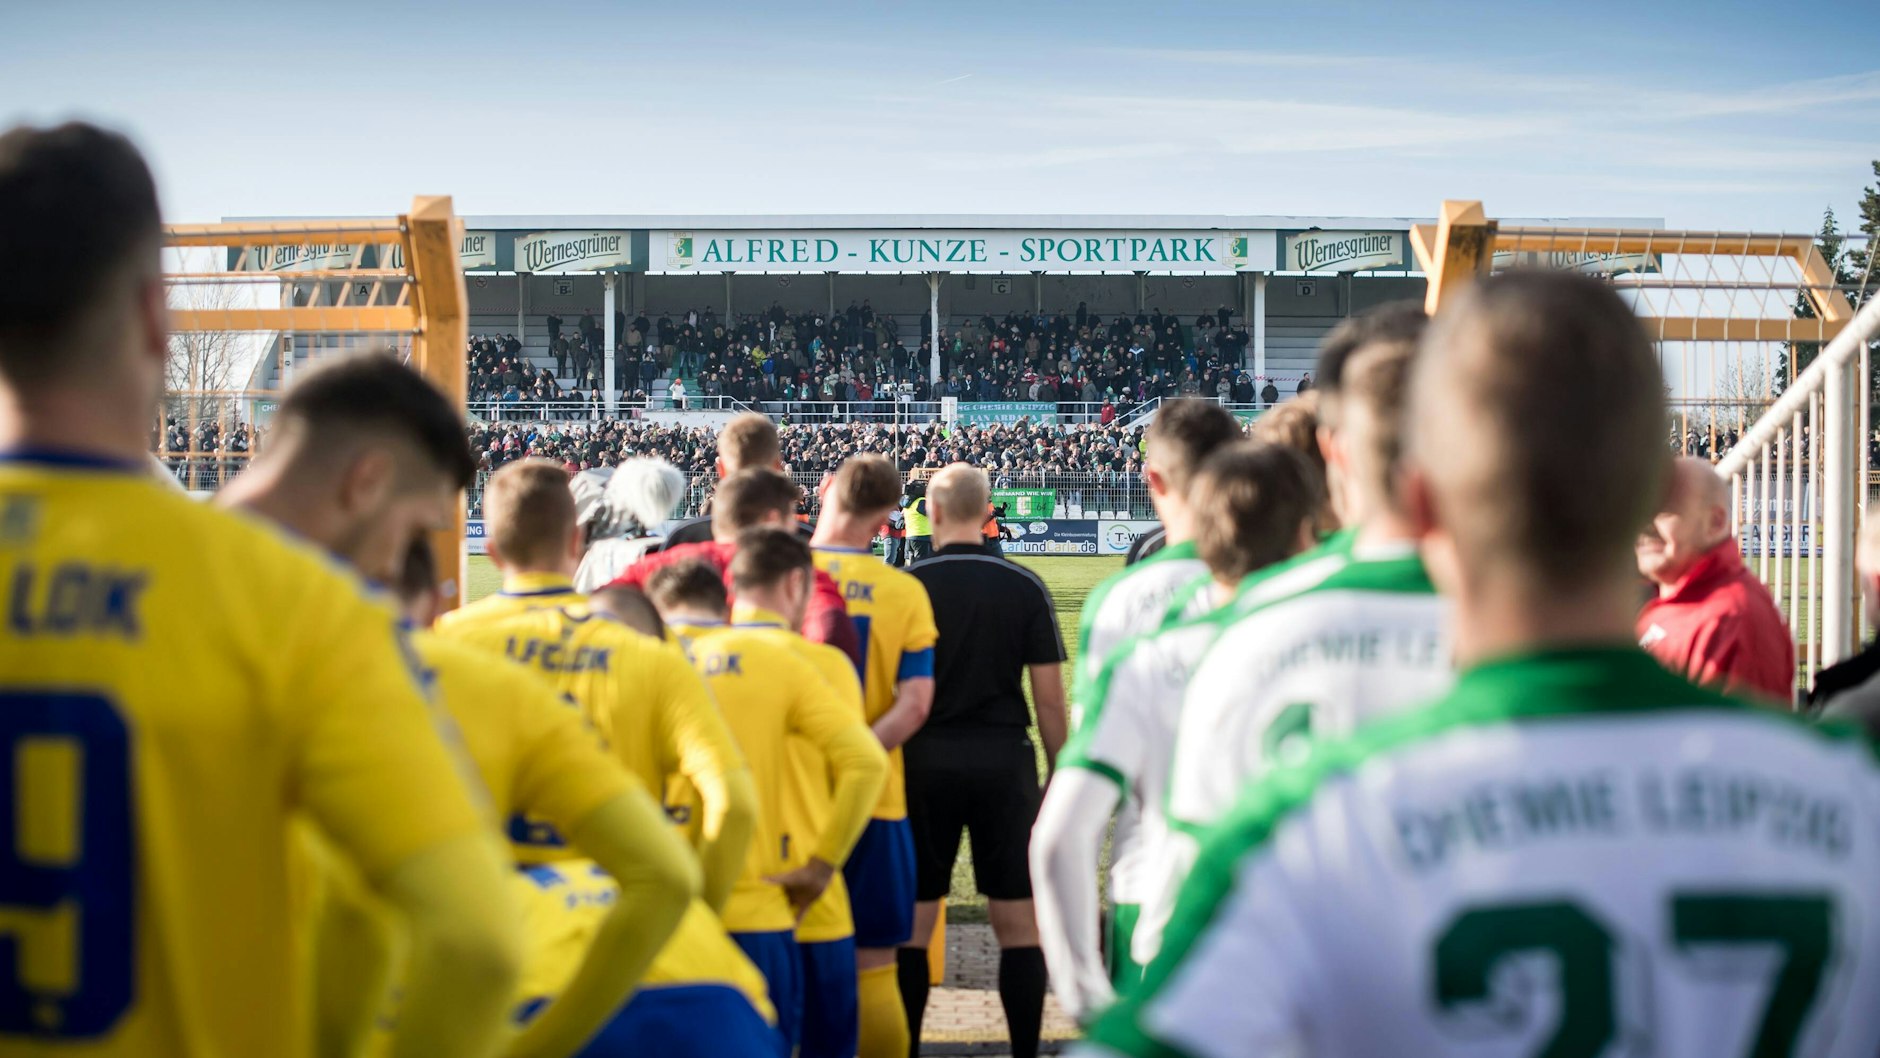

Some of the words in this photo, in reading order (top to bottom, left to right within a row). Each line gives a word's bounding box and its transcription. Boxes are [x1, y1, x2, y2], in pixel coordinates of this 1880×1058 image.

[524, 233, 621, 271] Wernesgrüner
[701, 238, 839, 263] ALFRED
[868, 239, 988, 263] KUNZE
[1019, 237, 1217, 262] SPORTPARK
[1294, 232, 1393, 271] Wernesgrüner
[359, 285, 368, 295] A
[559, 285, 568, 295] B
[997, 284, 1006, 294] C
[1302, 286, 1311, 296] D
[1000, 540, 1096, 552] CarlundCarla.de
[0, 690, 135, 1043] 9
